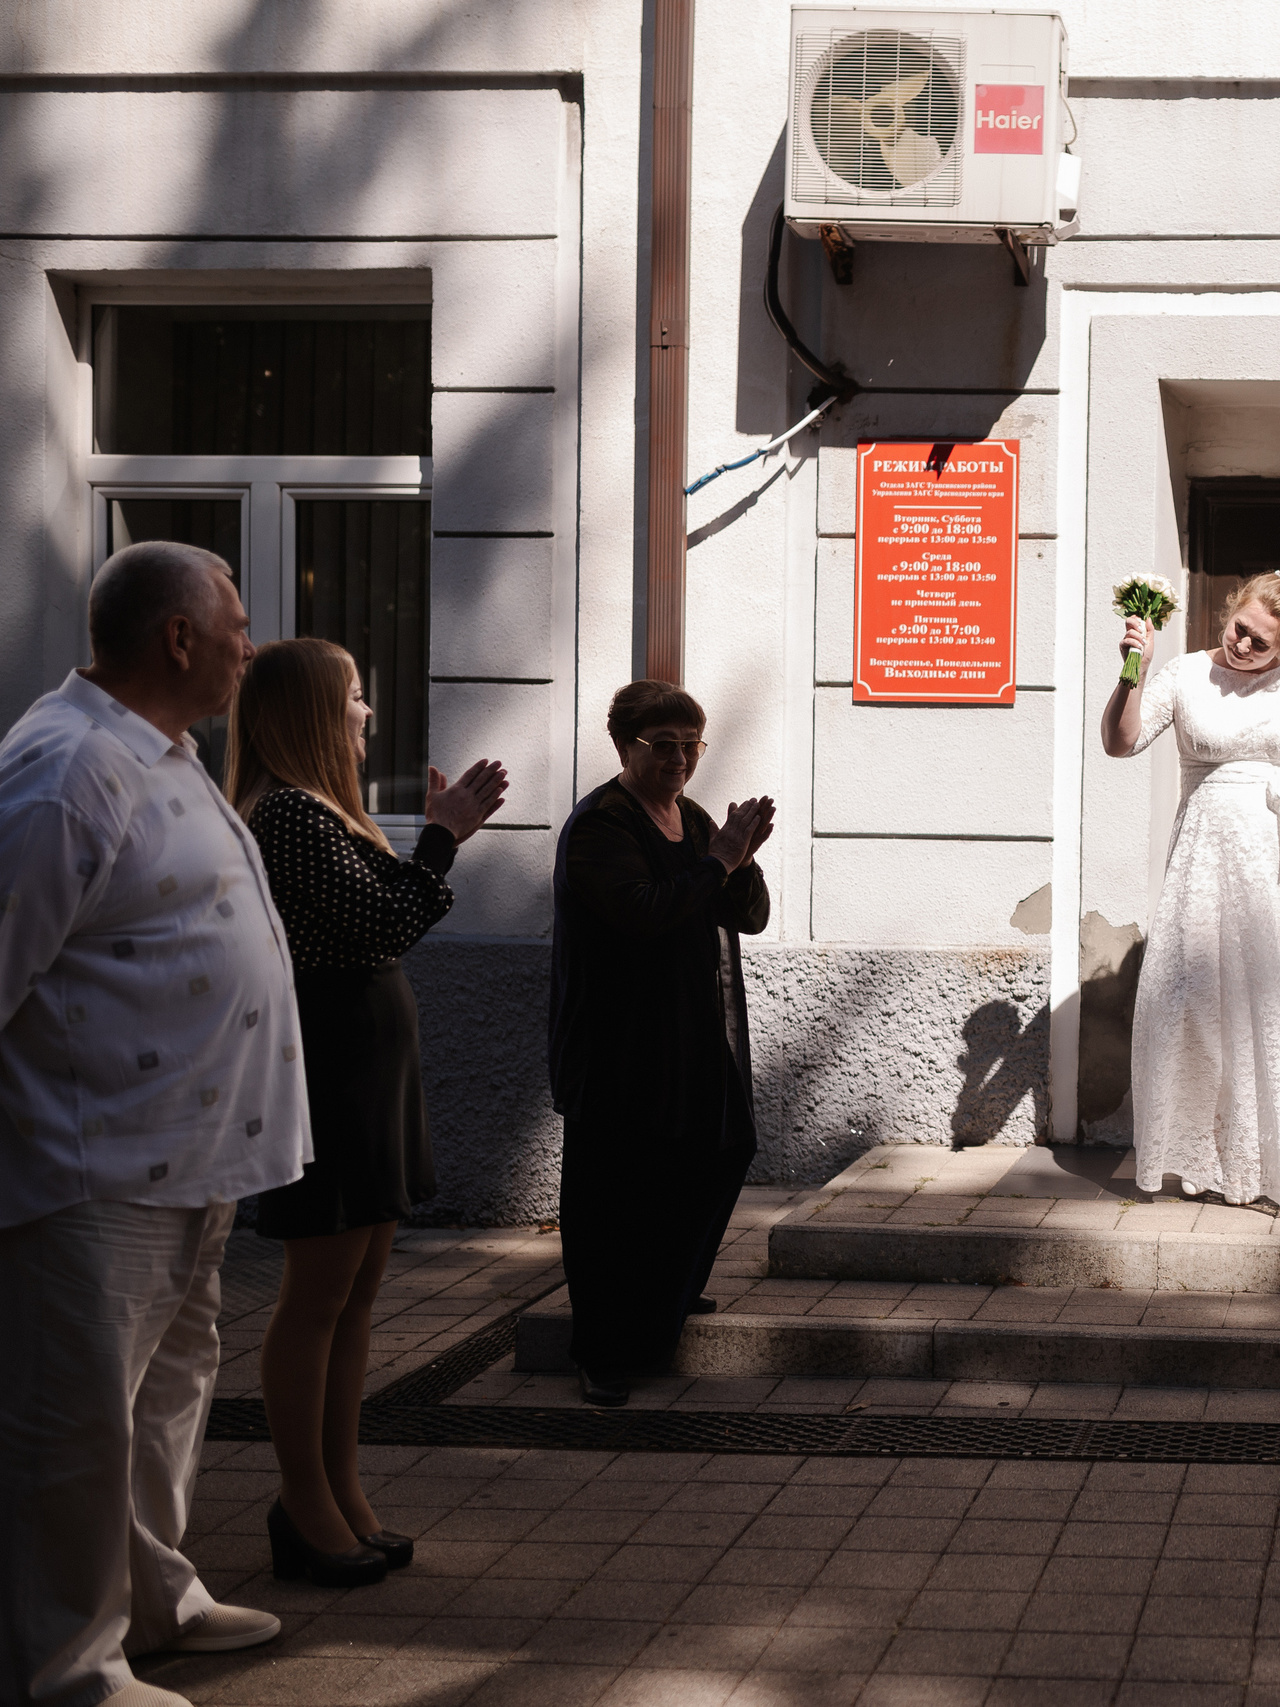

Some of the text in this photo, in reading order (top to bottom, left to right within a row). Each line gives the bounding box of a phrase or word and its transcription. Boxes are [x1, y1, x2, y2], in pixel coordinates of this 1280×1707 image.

[976, 110, 1042, 130] Haier
[873, 460, 1004, 473] РЕЖИМ РАБОТЫ
[879, 481, 905, 490] Отдела
[905, 481, 926, 489] ЗАГС
[972, 482, 997, 491] района
[872, 488, 1005, 499] Управления ЗАГС Краснодарского края
[893, 514, 982, 525] Вторник, Суббота
[900, 523, 930, 535] 9:00
[931, 528, 944, 536] до
[946, 523, 983, 535] 18:00
[877, 536, 921, 545] перерыв
[930, 535, 956, 544] 13:00
[971, 536, 998, 544] 13:50
[921, 552, 952, 562] Среда
[900, 561, 930, 572] 9:00
[945, 561, 982, 572] 18:00
[876, 573, 920, 583] перерыв
[929, 573, 956, 582] 13:00
[957, 574, 969, 582] до
[971, 573, 997, 582] 13:50
[916, 589, 957, 600] Четверг
[904, 598, 957, 609] приемный
[958, 600, 982, 609] день
[913, 614, 958, 625] Пятница
[899, 624, 929, 636] 9:00
[929, 629, 942, 637] до
[944, 624, 981, 636] 17:00
[875, 636, 919, 646] перерыв
[929, 636, 955, 645] 13:00
[955, 638, 968, 646] до
[970, 636, 996, 645] 13:40
[869, 658, 1002, 668] Воскресенье, Понедельник
[884, 667, 986, 680] Выходные дни
